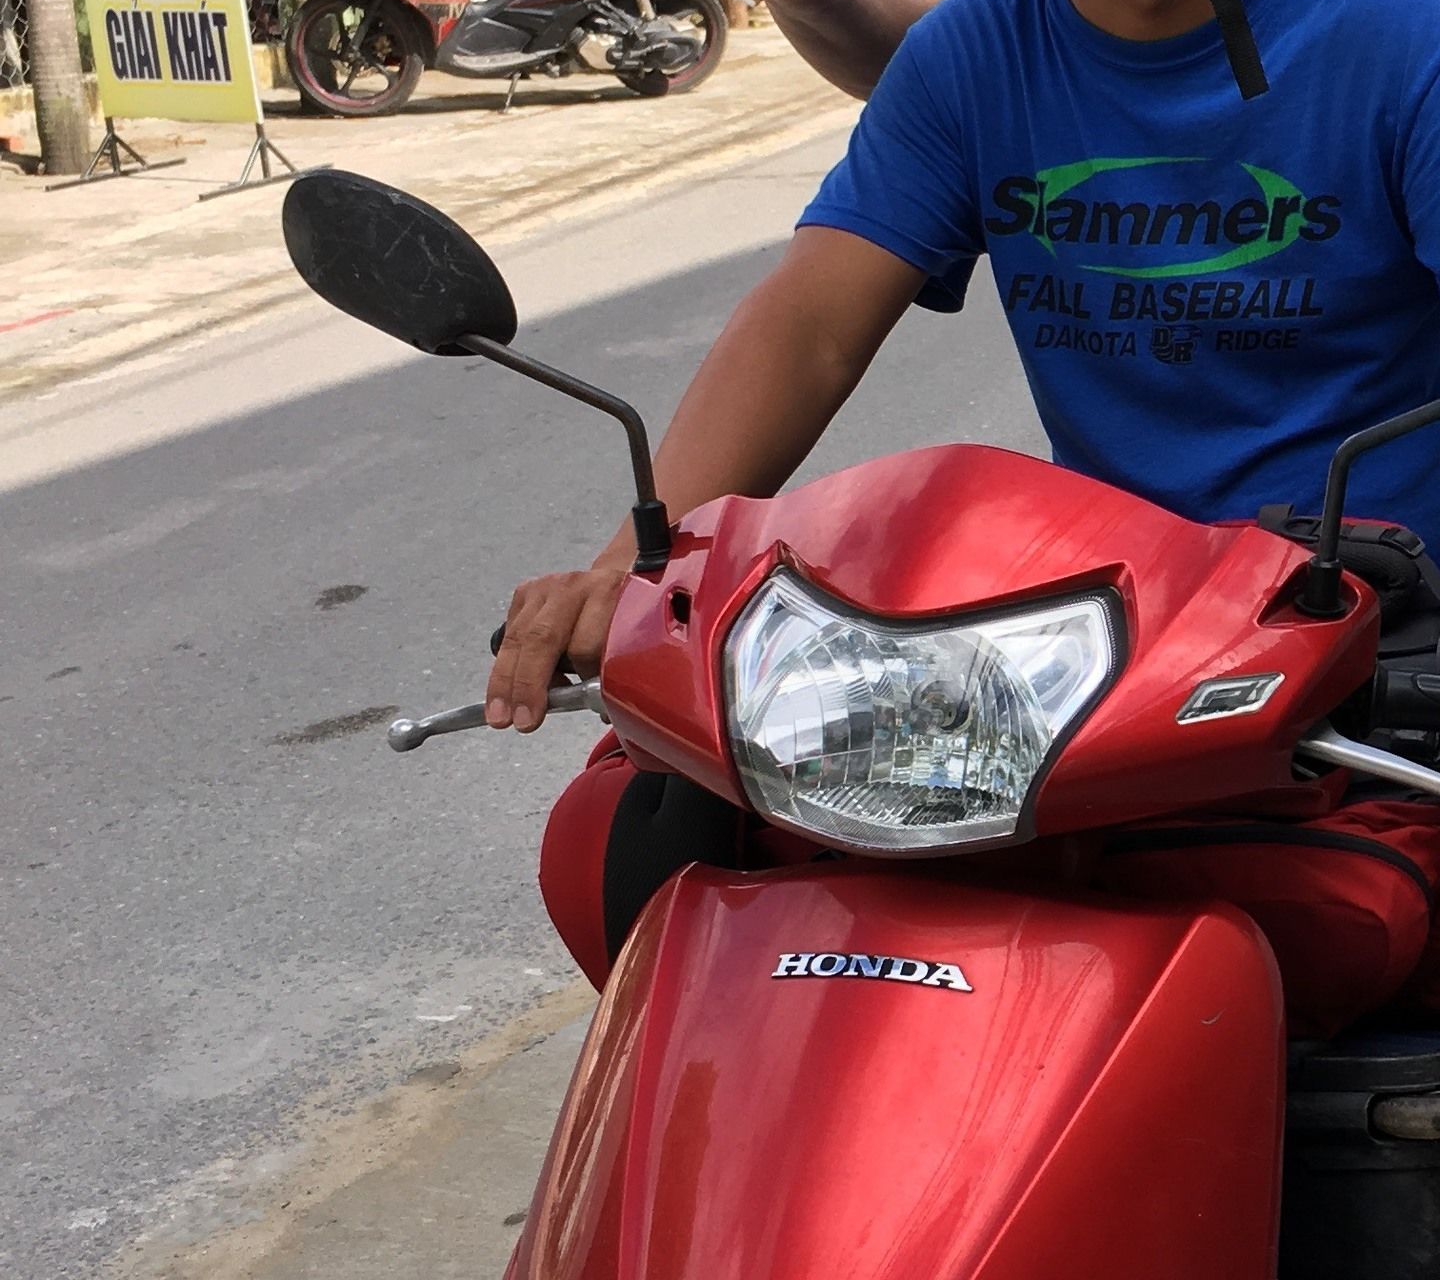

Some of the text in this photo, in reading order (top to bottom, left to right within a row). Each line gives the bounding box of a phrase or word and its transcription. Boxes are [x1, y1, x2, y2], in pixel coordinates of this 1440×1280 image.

[162, 0, 232, 82] KHÁT
[985, 175, 1343, 246] Slammers
[1006, 274, 1324, 322] FALL BASEBALL
[1034, 323, 1137, 358] DAKOTA
[1214, 327, 1302, 352] RIDGE
[771, 952, 974, 993] HONDA
